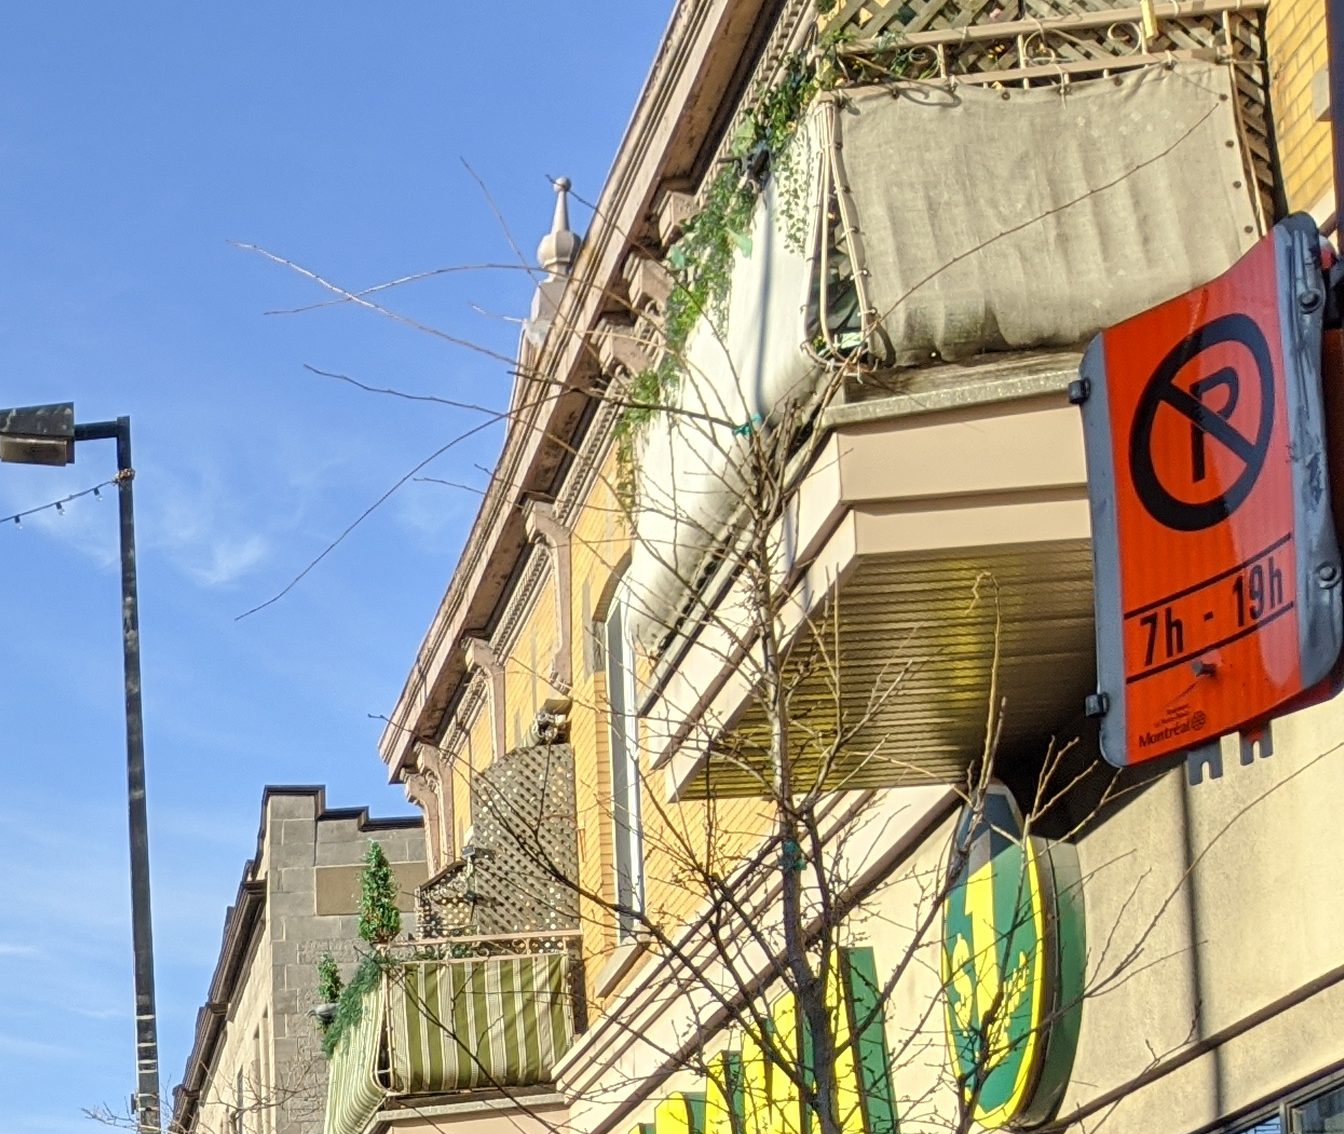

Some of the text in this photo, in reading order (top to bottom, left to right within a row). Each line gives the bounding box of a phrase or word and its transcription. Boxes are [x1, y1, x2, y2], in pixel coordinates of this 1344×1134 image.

[1139, 606, 1184, 667] 7h
[1231, 556, 1284, 628] 19h
[1138, 719, 1192, 749] Montréal
